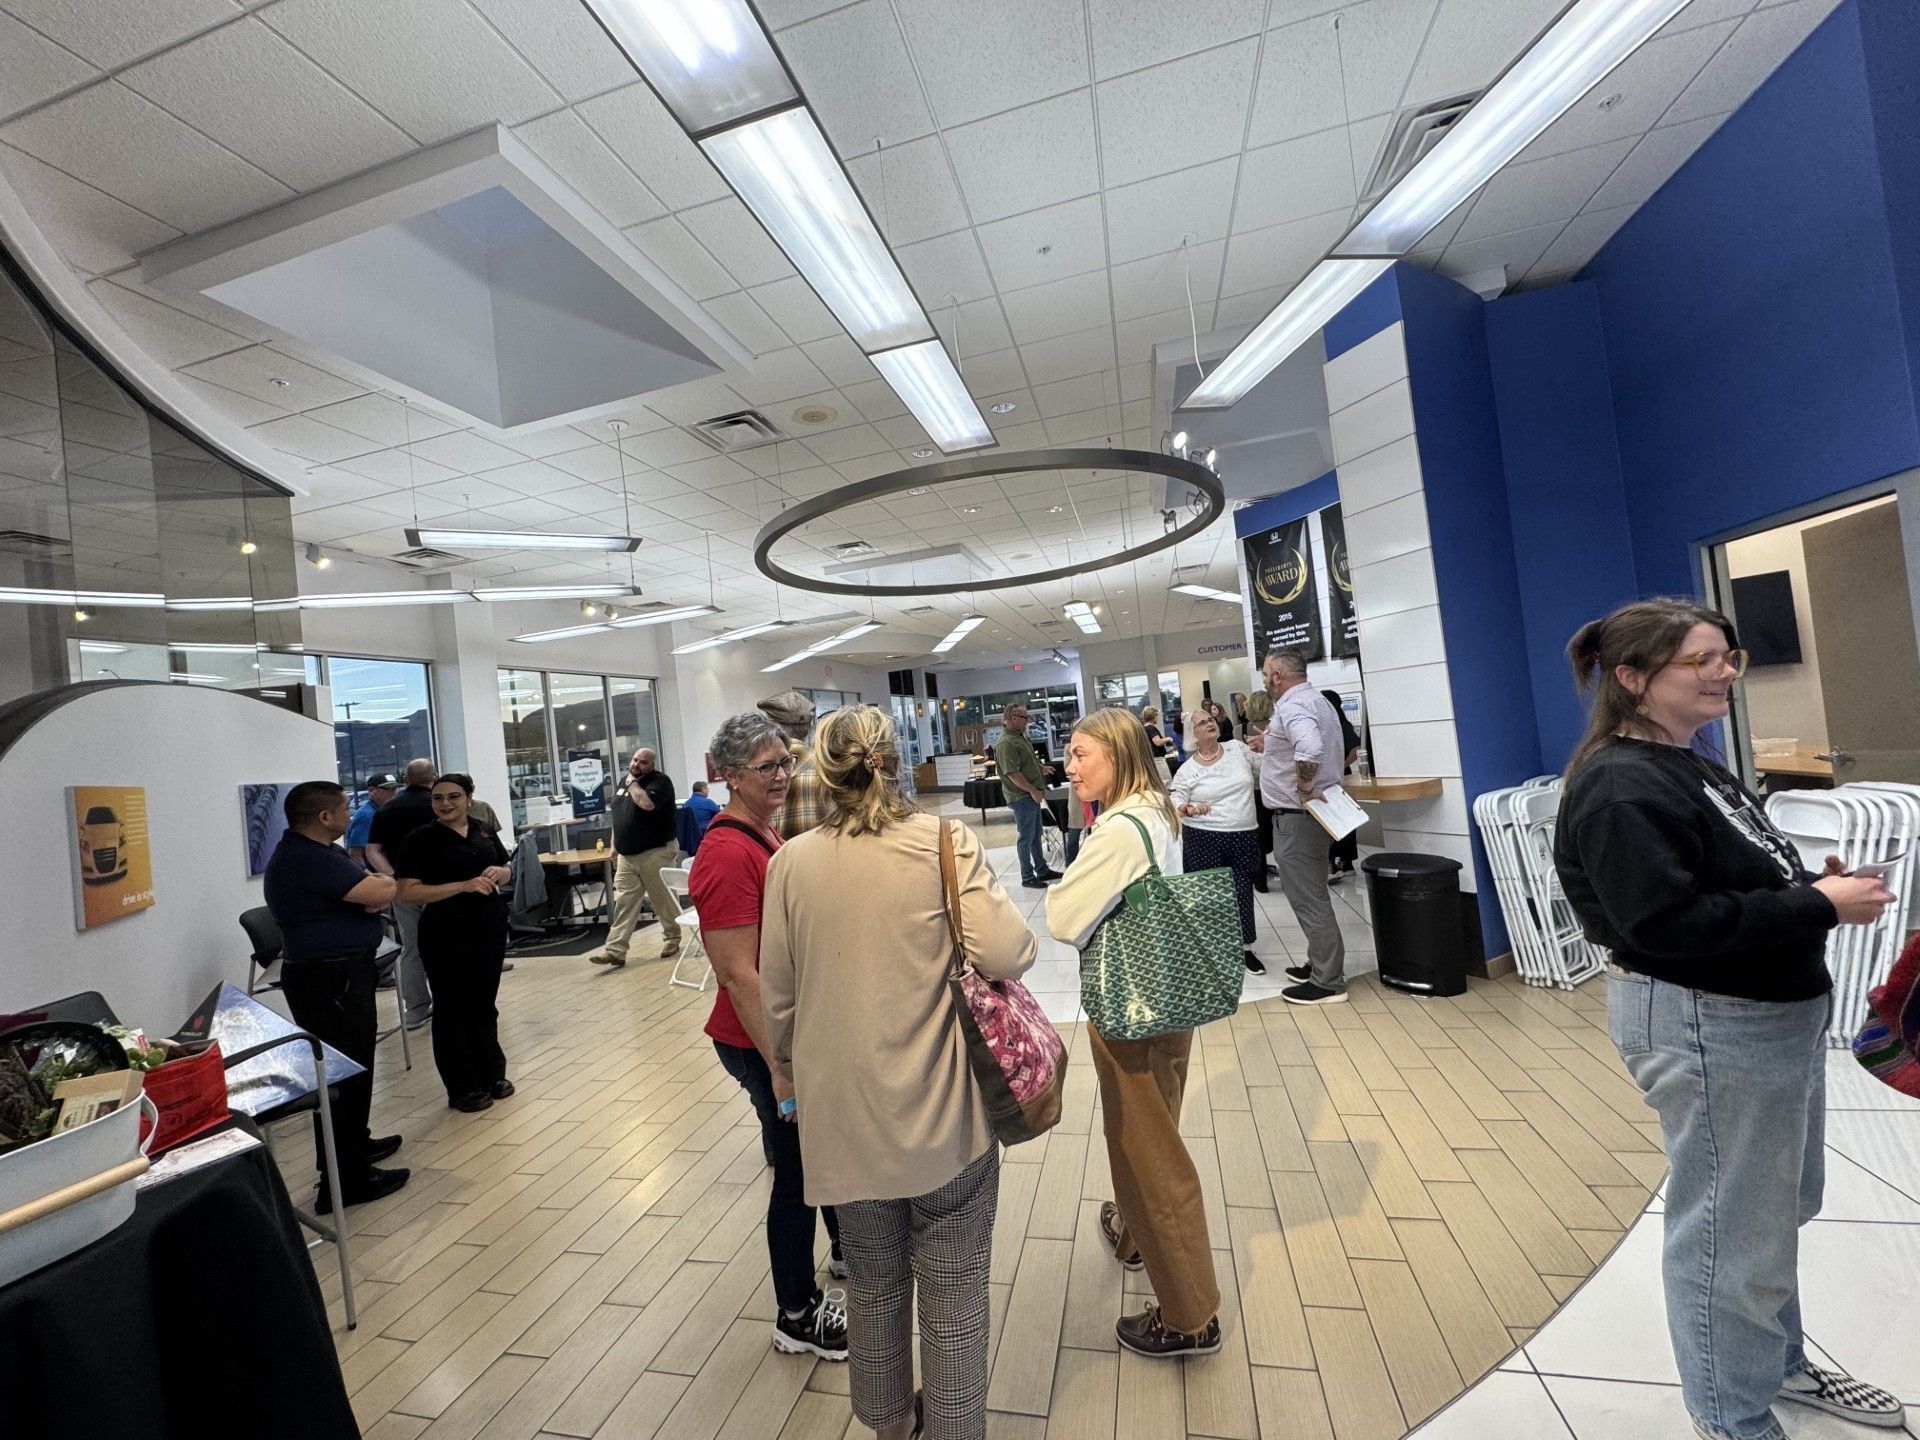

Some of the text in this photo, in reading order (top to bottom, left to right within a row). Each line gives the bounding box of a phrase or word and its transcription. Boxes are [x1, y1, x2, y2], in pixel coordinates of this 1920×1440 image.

[1264, 567, 1298, 587] AWARD
[1278, 612, 1293, 622] 2015
[1197, 643, 1243, 654] CUSTOMER
